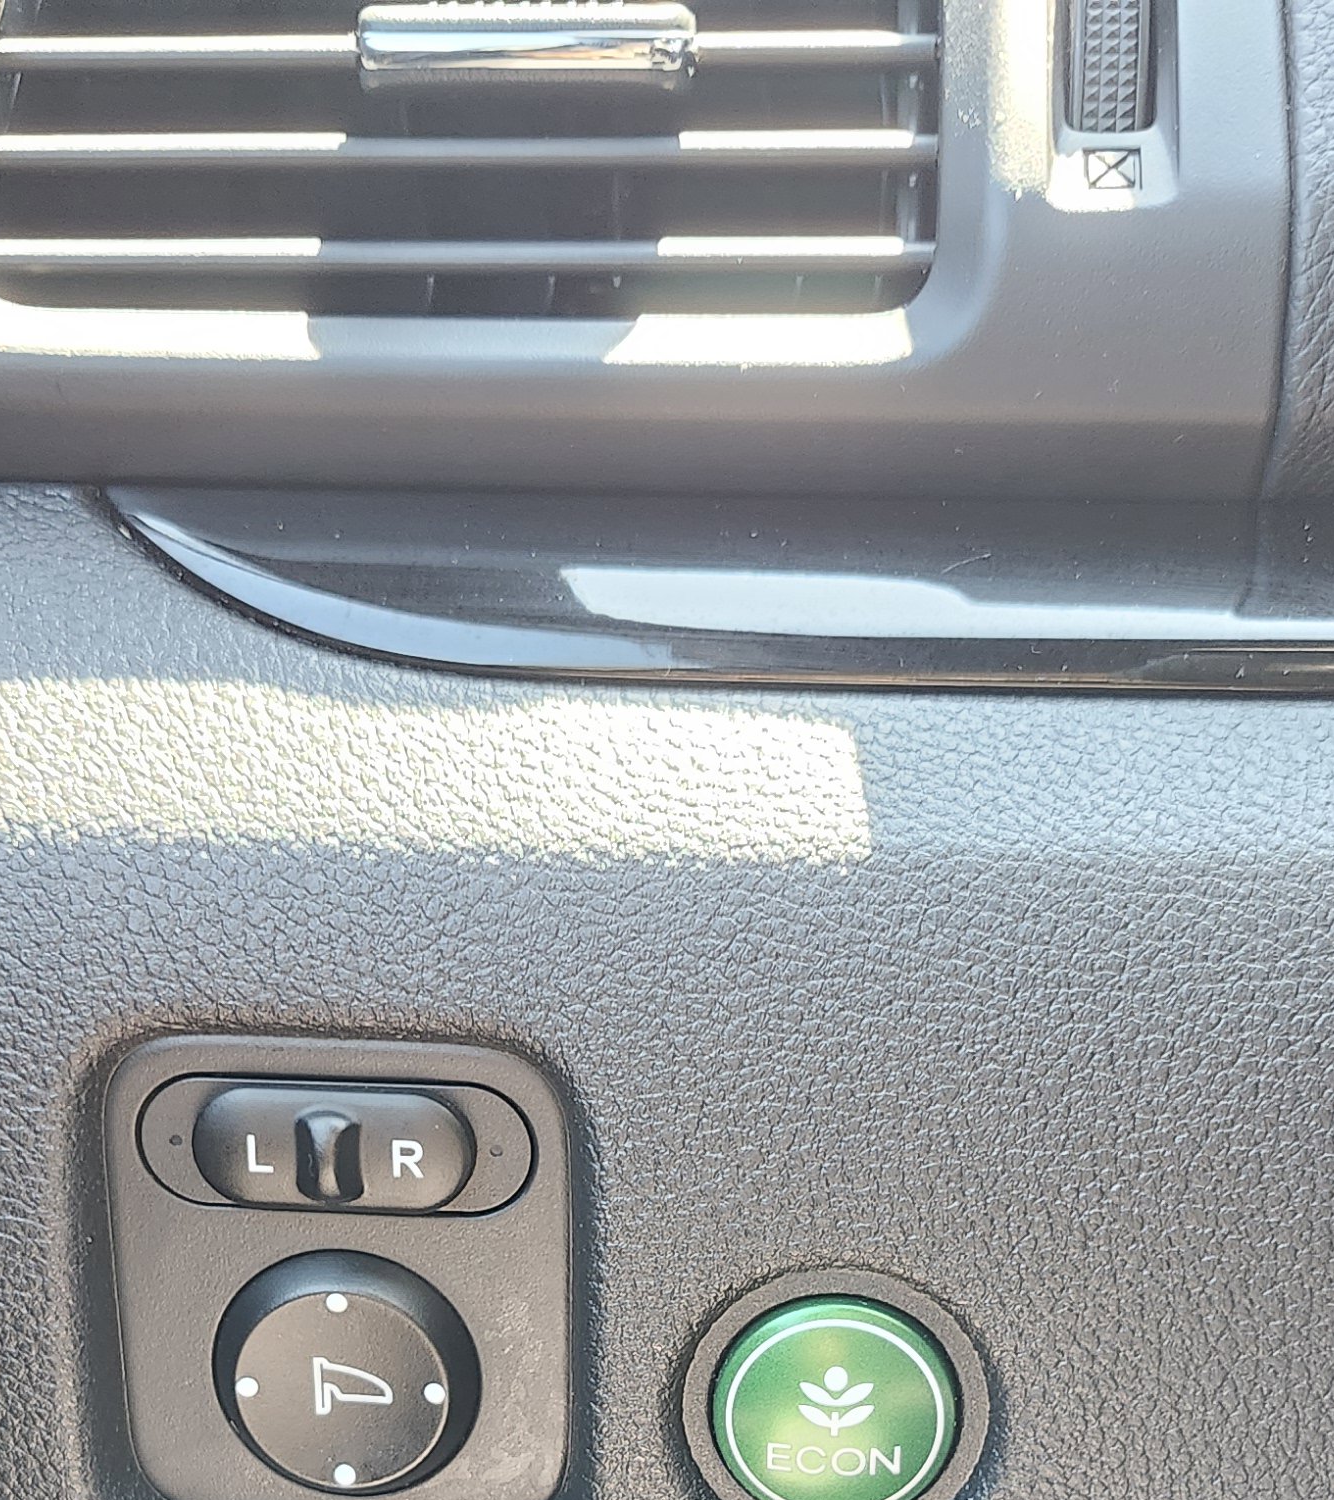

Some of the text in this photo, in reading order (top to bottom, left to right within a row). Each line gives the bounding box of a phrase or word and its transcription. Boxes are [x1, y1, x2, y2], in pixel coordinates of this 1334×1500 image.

[246, 1134, 275, 1174] L
[391, 1139, 425, 1178] R
[765, 1442, 903, 1478] ECON
